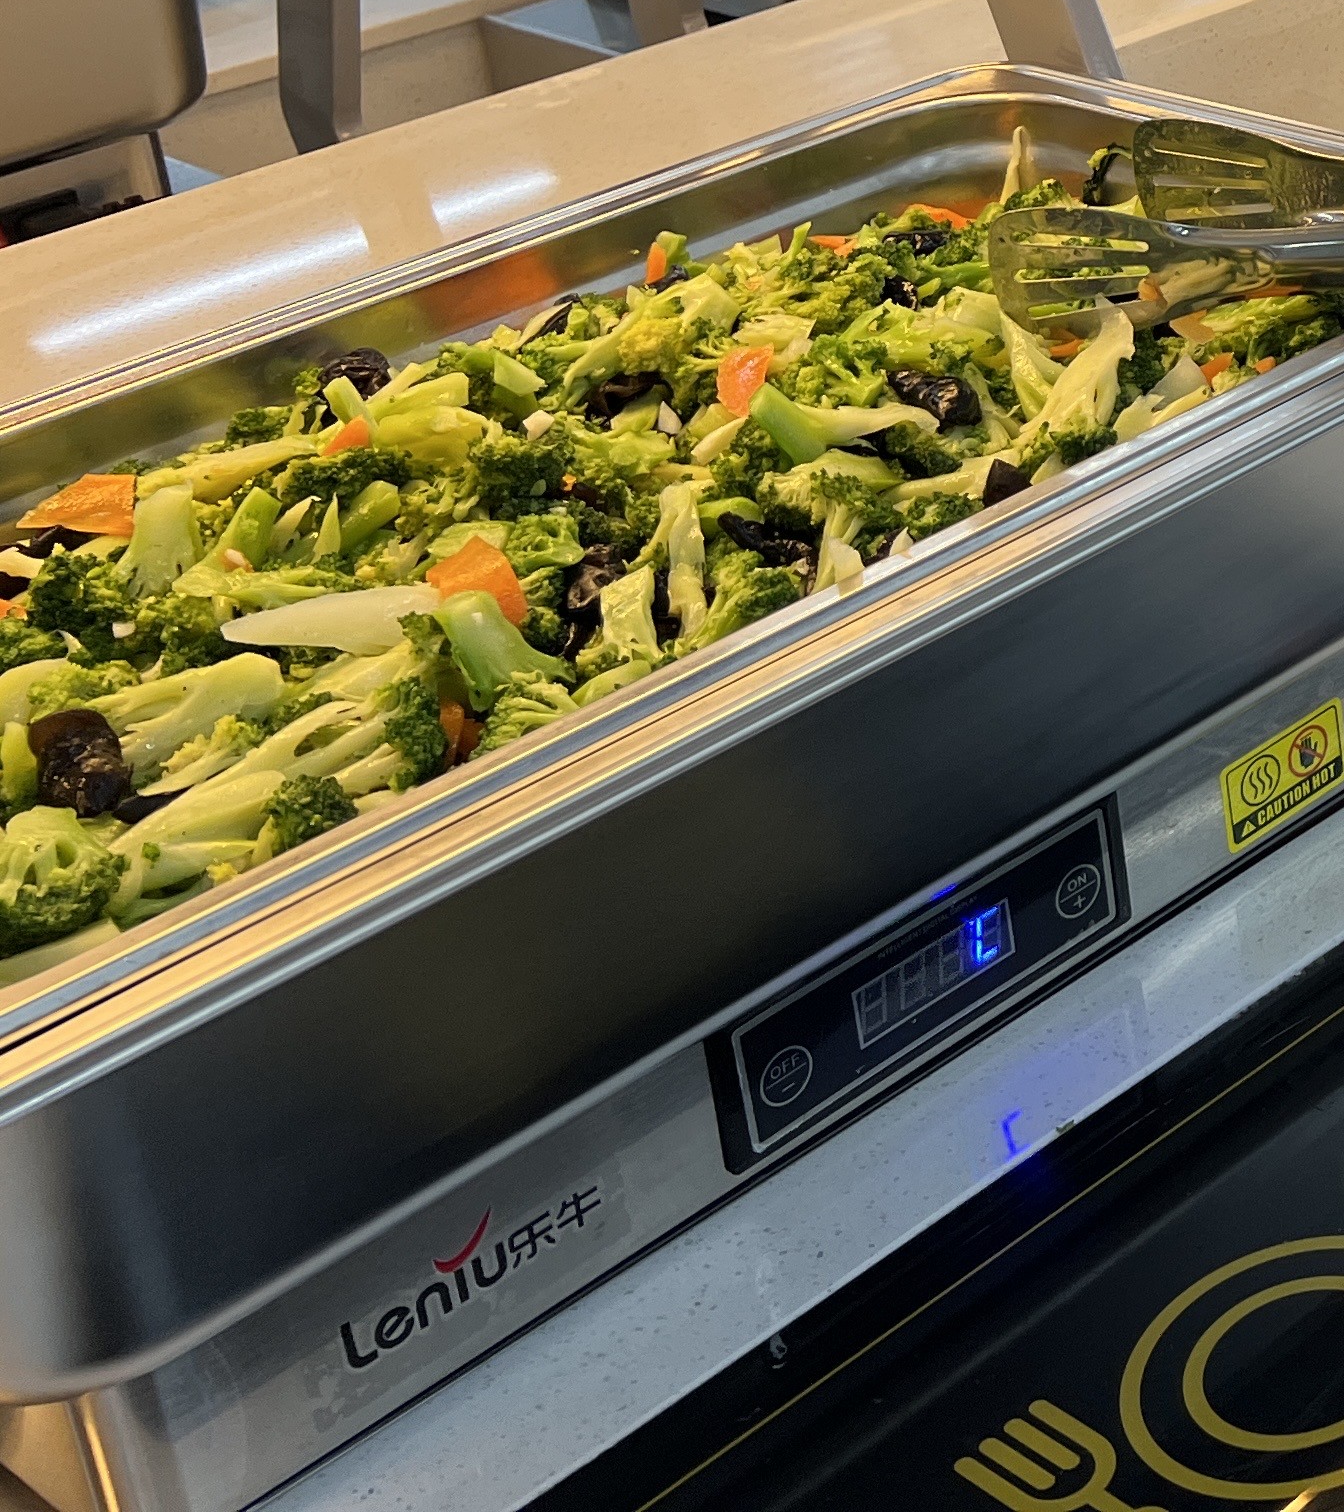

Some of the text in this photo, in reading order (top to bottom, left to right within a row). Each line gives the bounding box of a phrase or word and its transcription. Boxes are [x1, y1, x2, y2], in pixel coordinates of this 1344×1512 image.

[1258, 762, 1336, 827] CAUTION HOT
[1067, 872, 1088, 893] ON
[769, 1053, 801, 1081] OFF
